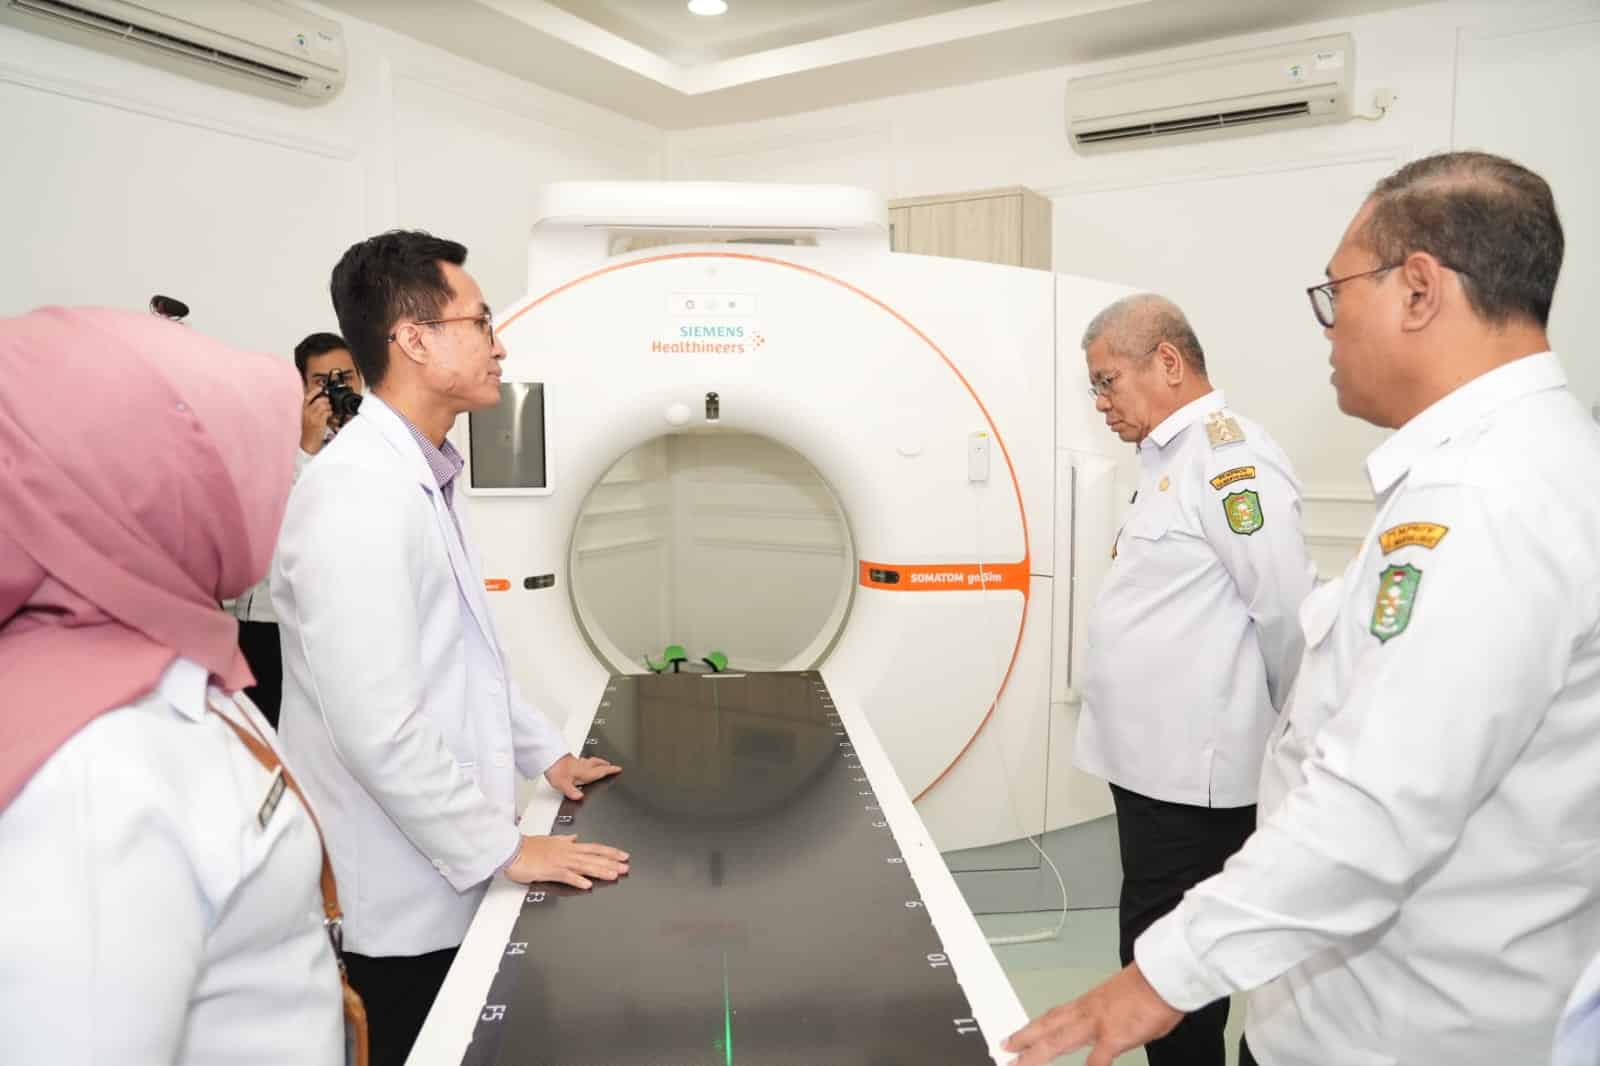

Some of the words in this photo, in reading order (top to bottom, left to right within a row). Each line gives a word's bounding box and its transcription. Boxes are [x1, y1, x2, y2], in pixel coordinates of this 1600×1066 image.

[680, 326, 744, 337] SIEMENS
[652, 340, 745, 353] Healthineers
[911, 573, 964, 584] SOMATOM
[967, 572, 1003, 585] goSim
[927, 953, 949, 968] 10
[481, 1004, 506, 1021] F5
[953, 1018, 978, 1034] 11
